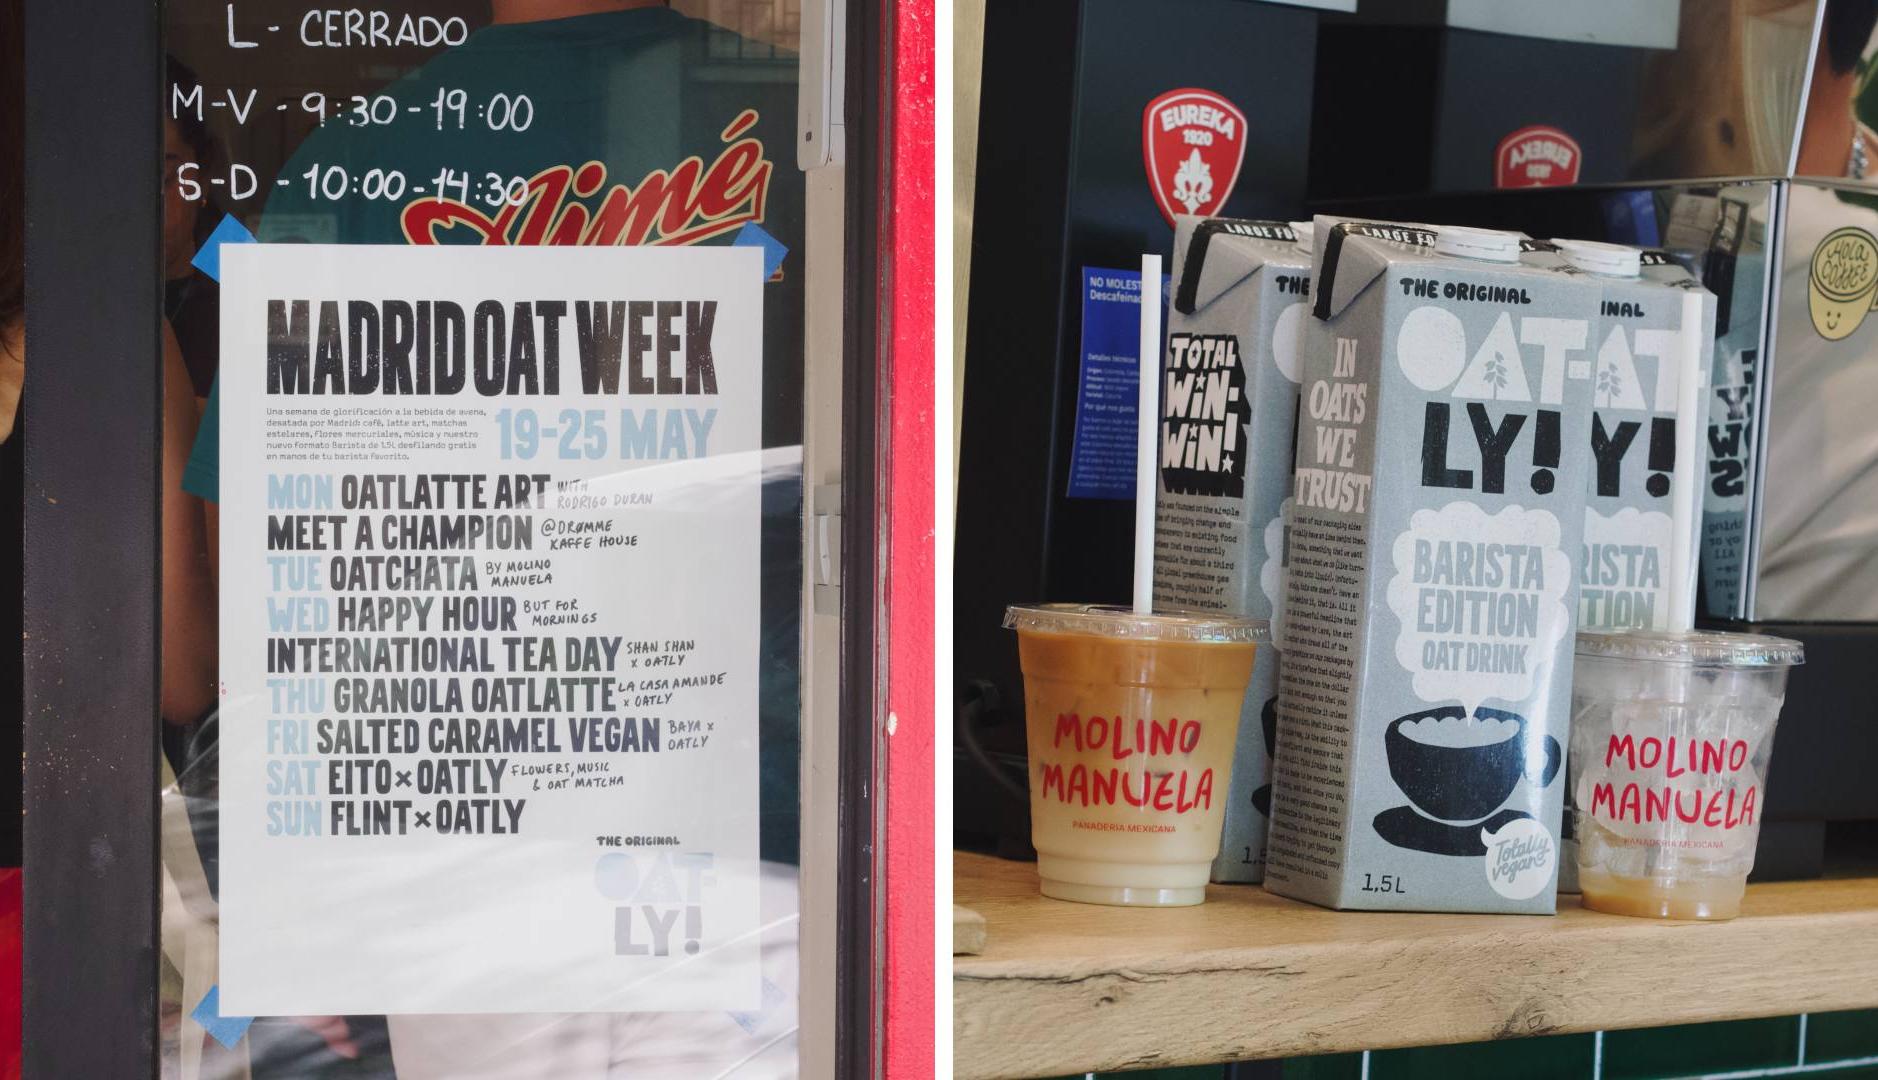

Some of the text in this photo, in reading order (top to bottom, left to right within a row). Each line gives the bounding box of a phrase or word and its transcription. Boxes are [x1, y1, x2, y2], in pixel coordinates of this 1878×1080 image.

[301, 9, 468, 48] CERRADO
[1160, 104, 1236, 140] EUREKA
[1183, 129, 1213, 146] 1920
[1362, 227, 1411, 244] LARGE
[1089, 276, 1142, 290] NO MOLEST
[1275, 275, 1310, 296] THE
[1399, 277, 1531, 305] THE ORIGINAL
[1600, 300, 1644, 317] INAL
[267, 299, 719, 397] MADRID OAT WEEK
[1170, 337, 1237, 369] TOTAL
[1333, 337, 1358, 378] IN
[266, 407, 283, 417] Una
[285, 407, 318, 417] semana
[320, 407, 331, 417] de
[333, 407, 393, 417] glorificación
[403, 407, 412, 417] la
[414, 407, 444, 417] bebida
[446, 407, 457, 417] de
[458, 407, 487, 417] avena,
[1308, 380, 1367, 425] OATS
[266, 418, 308, 428] desatada
[309, 418, 326, 428] por
[362, 418, 384, 428] café,
[386, 418, 410, 428] latte
[412, 418, 429, 428] art,
[431, 418, 468, 428] matchas
[266, 430, 313, 439] estelares,
[314, 430, 343, 439] flores
[345, 430, 402, 439] mercuriales,
[404, 430, 434, 439] música
[443, 430, 479, 439] nuestro
[495, 408, 719, 461] 19-25 MAY
[266, 441, 293, 451] nuevo
[294, 441, 330, 451] formato
[332, 441, 366, 451] Barista
[368, 441, 379, 451] de
[397, 441, 446, 451] desfilando
[449, 441, 477, 451] gratis
[266, 452, 410, 462] en manos de tu barista favorito.
[1315, 426, 1357, 467] WE
[1421, 400, 1562, 495] LY!
[1591, 410, 1676, 498] Y!
[267, 473, 551, 510] MON OATLATTE ART
[557, 478, 589, 493] WITH
[557, 492, 653, 509] RODRIGO DURAN
[1295, 468, 1372, 514] TRUST
[267, 514, 533, 550] MEET A CHAMPION
[550, 535, 638, 551] KAFFE HOUSE
[266, 555, 478, 591] TUE OATCHATA
[486, 559, 551, 576] BY MOLINO
[491, 573, 553, 588] MANUELA
[1412, 539, 1545, 591] BARISTA
[1580, 543, 1661, 589] RISTA
[267, 596, 517, 632] WED HAPPY HOUR
[523, 598, 579, 613] BUT FOR
[532, 612, 598, 627] MORNINGS
[1416, 588, 1540, 639] EDITION
[1581, 589, 1656, 630] TION
[267, 636, 623, 673] INTERNATIONAL TEA DAY
[626, 639, 695, 655] SHAN SHAN
[645, 655, 686, 668] OATLY
[1422, 640, 1529, 675] OAT DRINK
[266, 677, 617, 714] THU GRANOLA OATLATTE
[618, 672, 727, 693] LA CASA AMANDE
[635, 693, 673, 708] OATLY
[267, 717, 661, 755] FRI SALTED CARAMEL VEGAN
[667, 719, 702, 735] BAYA
[668, 735, 709, 751] OATLY
[1054, 713, 1201, 760] MOLINO
[511, 761, 610, 778] FLOWERS, MUSIC
[1606, 733, 1748, 779] MOLINO
[266, 760, 321, 796] SAT
[328, 759, 392, 795] EITO
[417, 759, 508, 794] OATLY
[547, 779, 570, 790] OAT
[575, 775, 624, 789] MATCHA
[1042, 764, 1214, 814] MANUELA
[266, 800, 322, 836] SUN
[331, 800, 413, 836] FLINT
[436, 799, 526, 835] OATLY
[1592, 782, 1757, 830] MANUELA
[596, 836, 681, 847] THE ORIGINAL
[1127, 824, 1177, 833] MEXICANA
[1495, 834, 1550, 866] Totally
[614, 905, 703, 957] LY!
